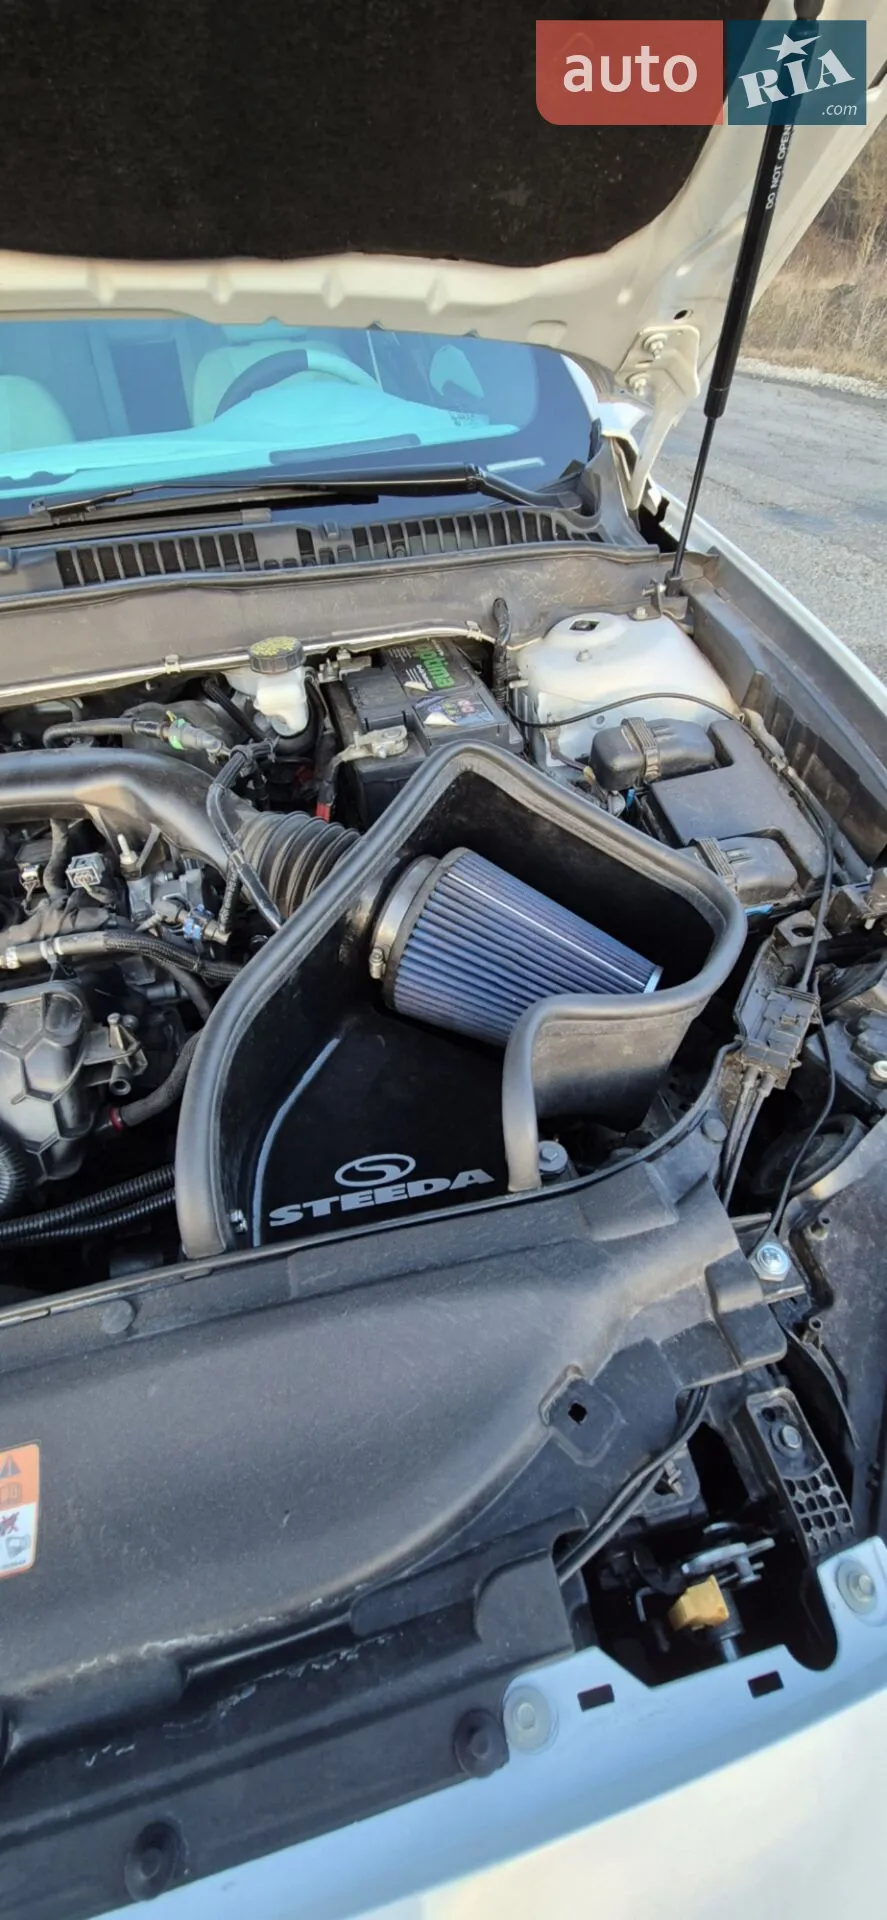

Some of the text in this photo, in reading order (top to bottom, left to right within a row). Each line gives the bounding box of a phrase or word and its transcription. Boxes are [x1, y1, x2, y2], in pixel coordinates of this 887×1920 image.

[770, 165, 782, 189] NOT
[765, 192, 776, 210] DO
[268, 1168, 495, 1227] STEEDA
